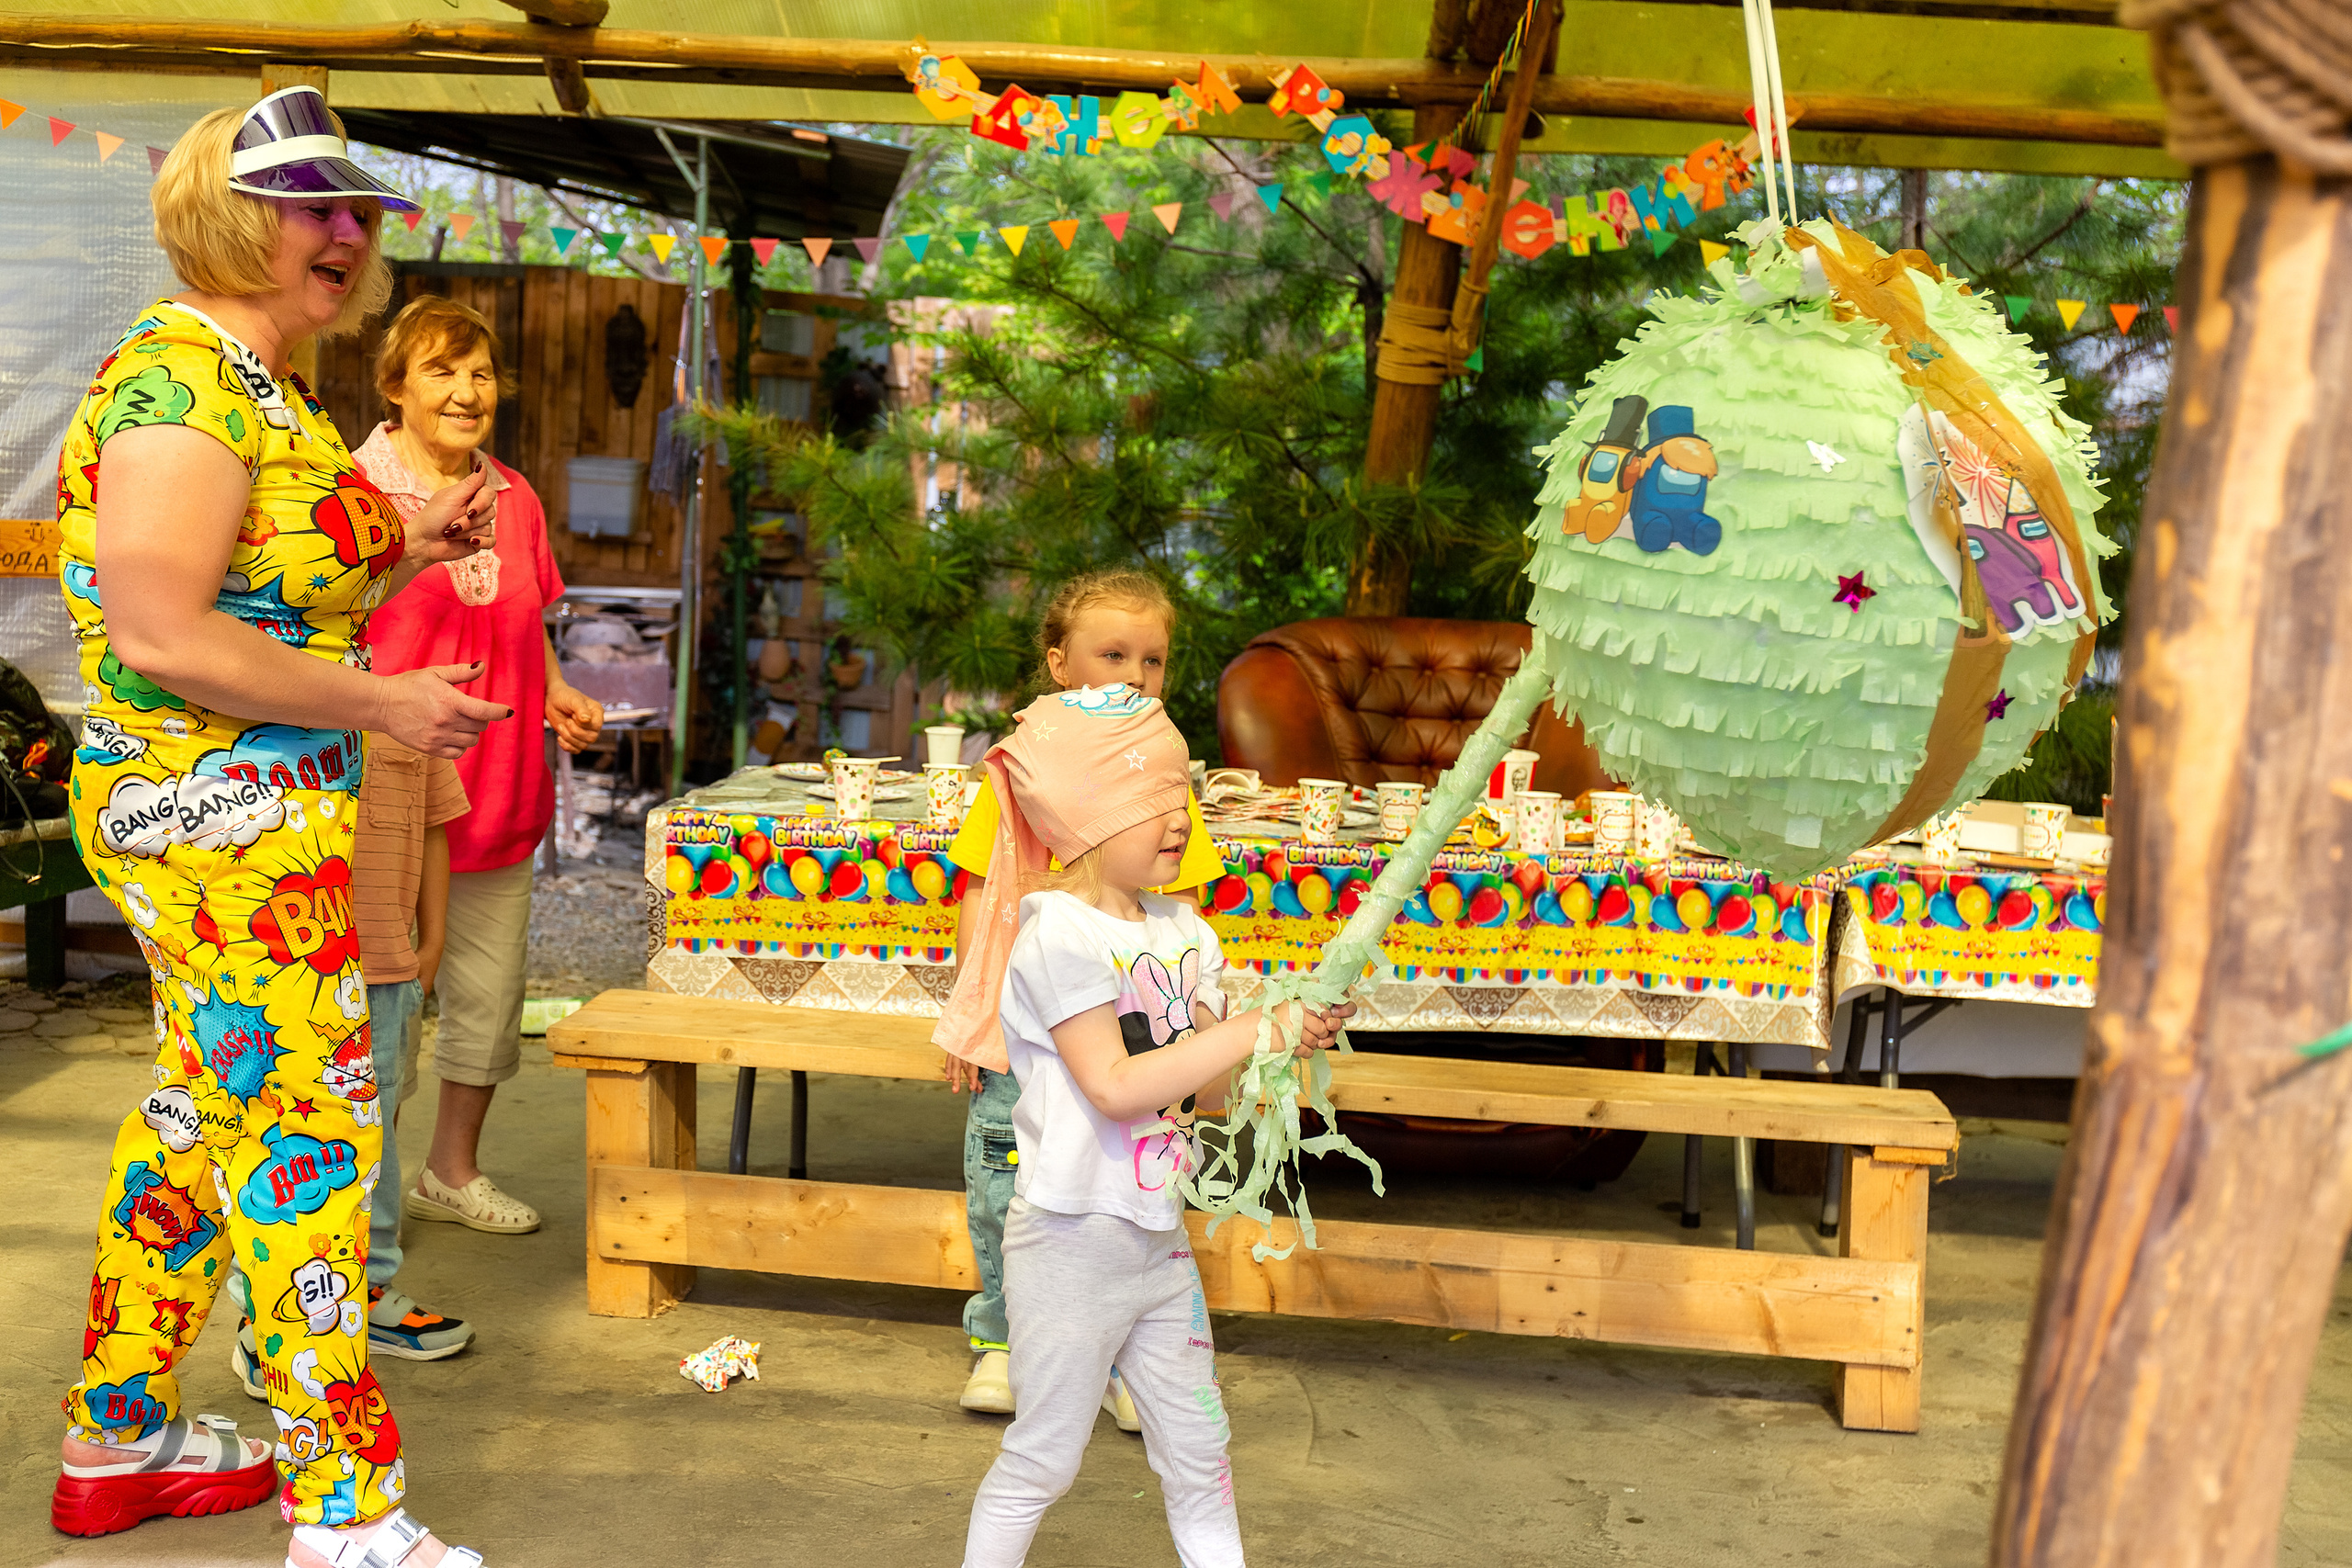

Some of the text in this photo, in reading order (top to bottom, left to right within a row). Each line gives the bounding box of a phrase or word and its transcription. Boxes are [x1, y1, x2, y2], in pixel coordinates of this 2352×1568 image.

[0, 551, 49, 571] ОДА
[774, 828, 857, 850] BIRTHDAY
[900, 831, 957, 852] BIRTH
[1287, 845, 1372, 868] BIRTHDAY
[1547, 857, 1624, 874] BIRTHDAY
